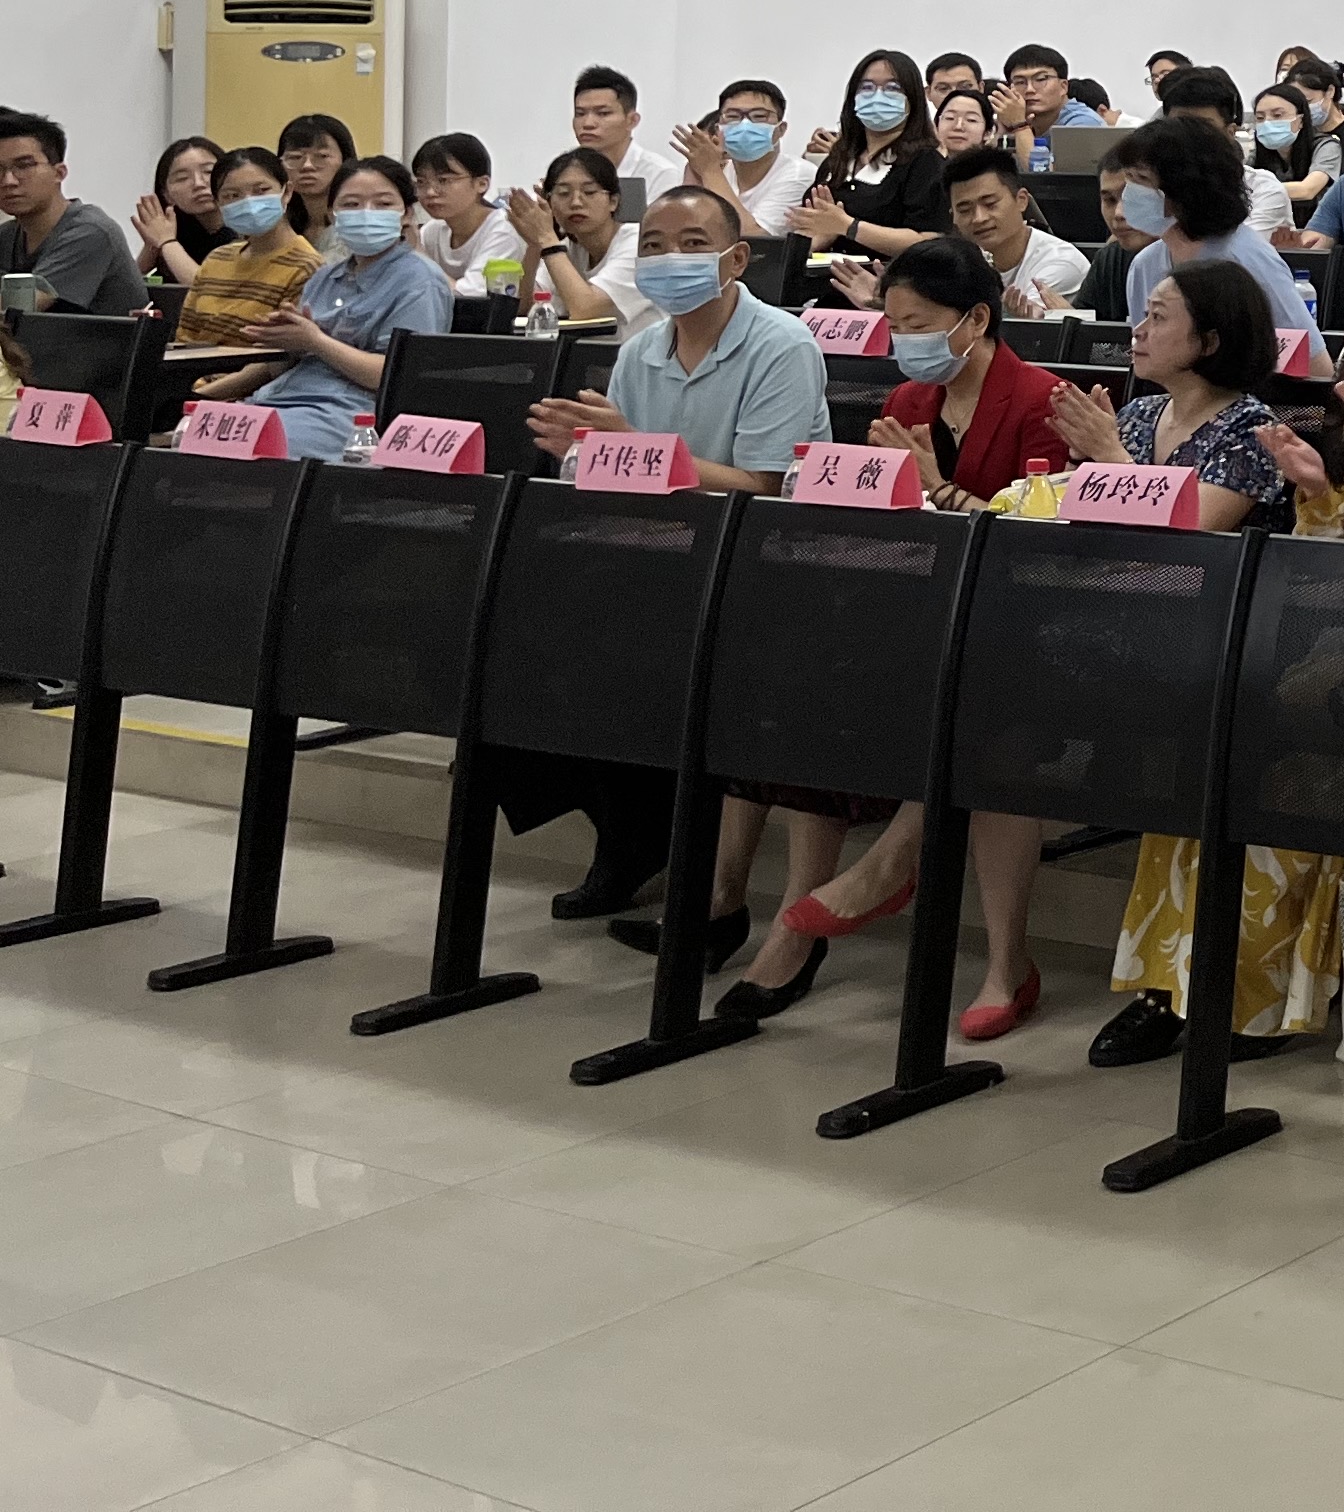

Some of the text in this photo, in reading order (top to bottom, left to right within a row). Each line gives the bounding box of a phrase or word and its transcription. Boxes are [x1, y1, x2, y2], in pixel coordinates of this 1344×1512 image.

[193, 411, 258, 442] 朱旭红
[386, 424, 461, 457] 陈大伟
[586, 443, 664, 477] 卢传坚
[812, 455, 887, 490] 吴薇
[1078, 471, 1170, 506] 杨玲玲
